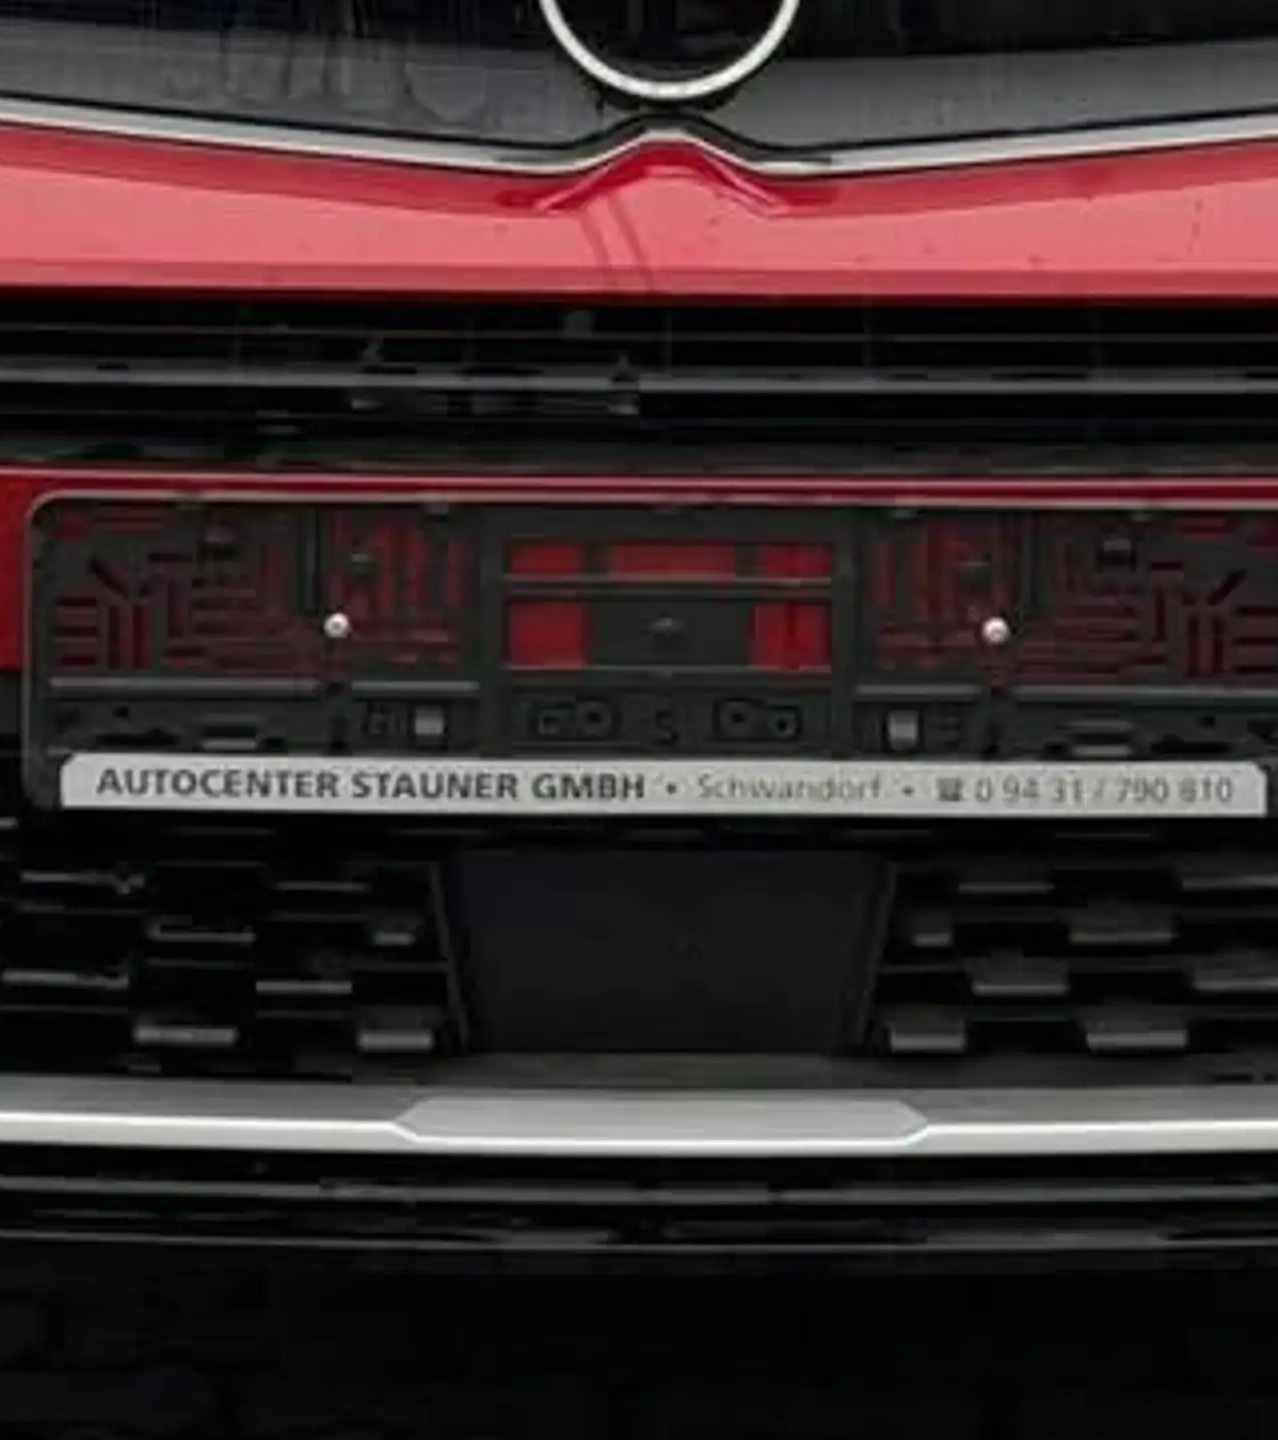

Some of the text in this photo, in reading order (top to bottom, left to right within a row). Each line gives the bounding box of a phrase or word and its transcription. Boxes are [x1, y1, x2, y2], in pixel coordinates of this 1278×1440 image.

[95, 767, 339, 799] AUTOCENTER
[350, 771, 519, 800] STAUNER
[531, 772, 645, 800] GMBH
